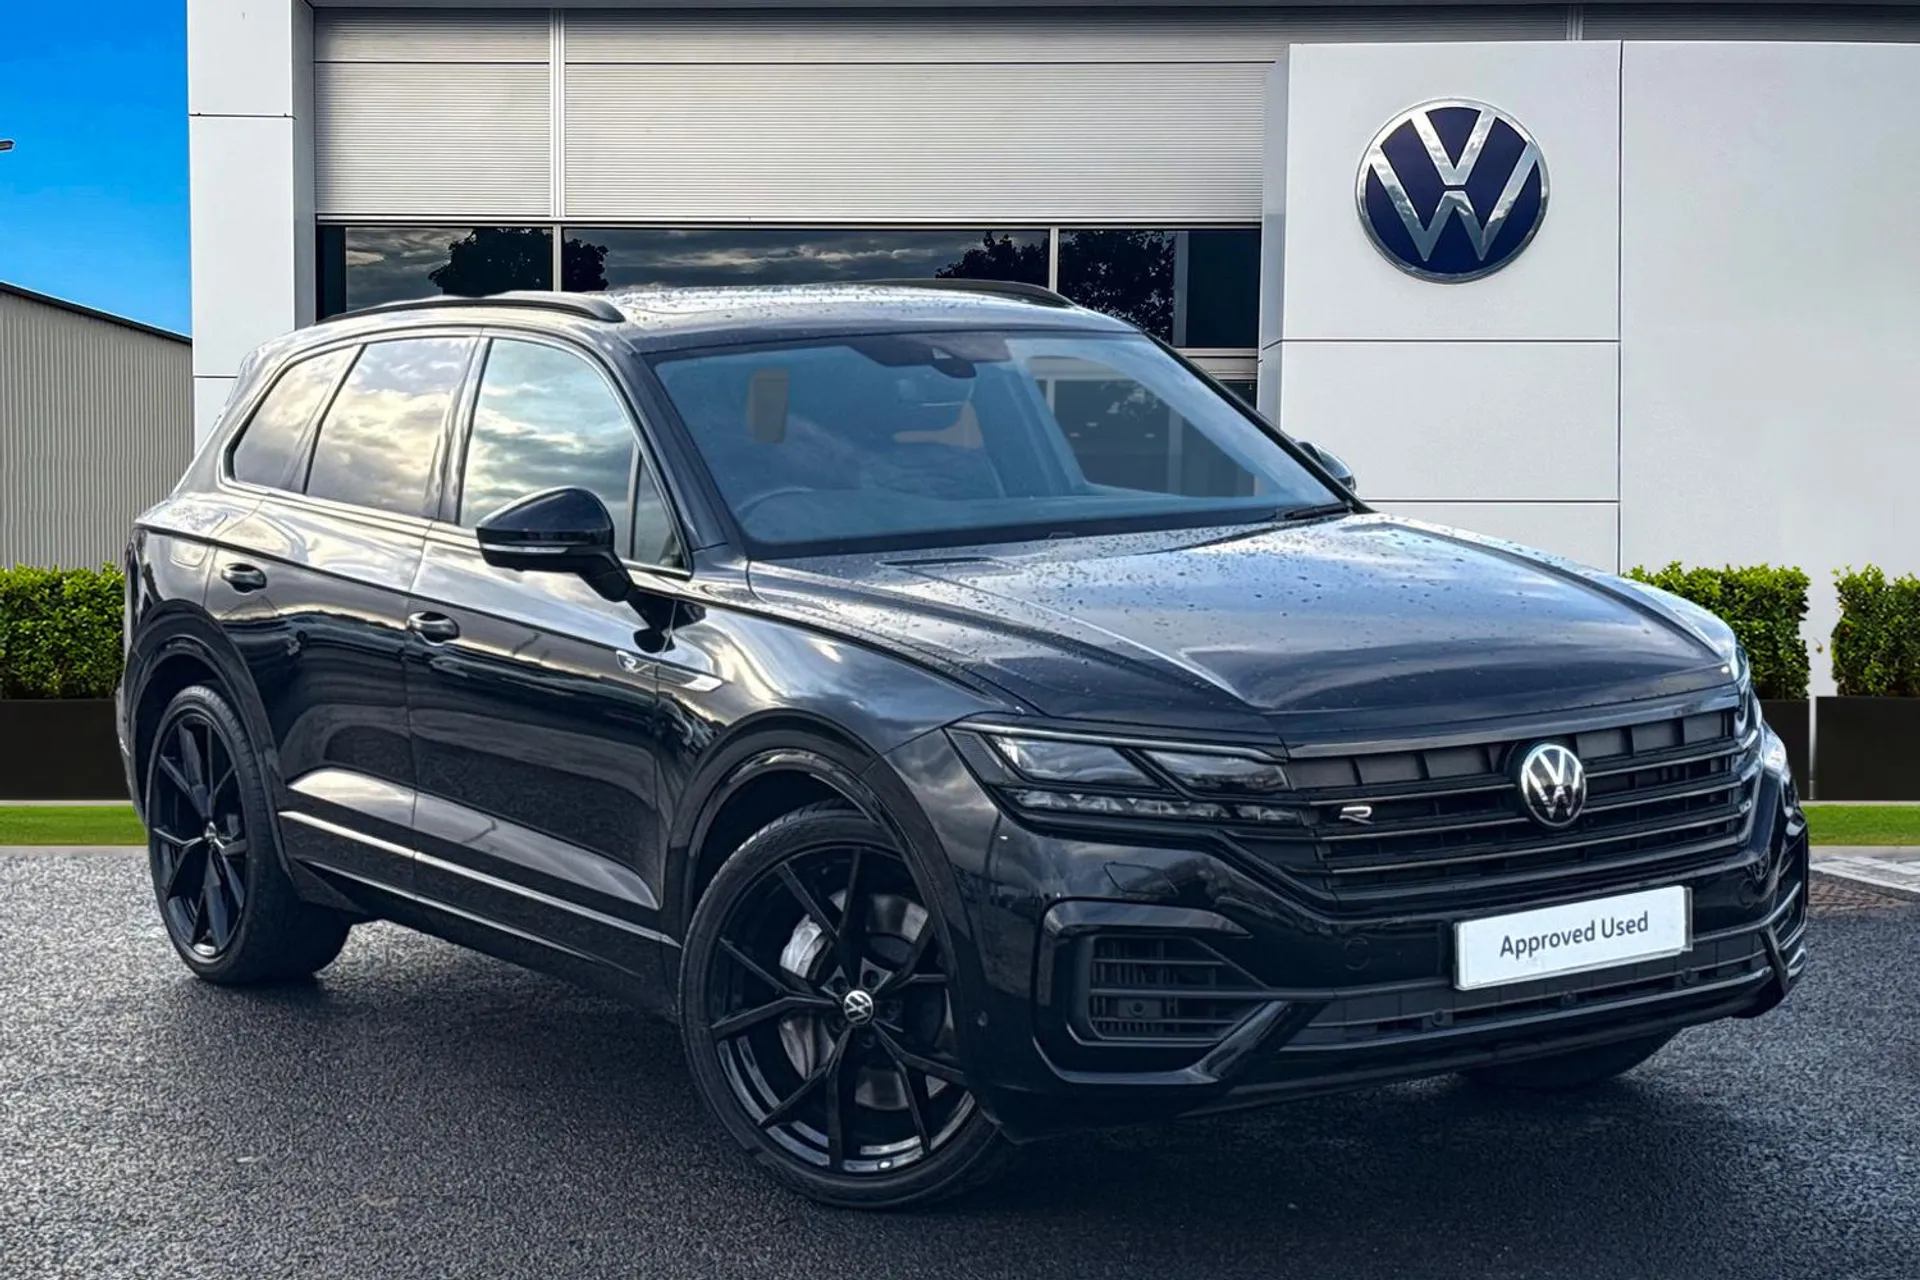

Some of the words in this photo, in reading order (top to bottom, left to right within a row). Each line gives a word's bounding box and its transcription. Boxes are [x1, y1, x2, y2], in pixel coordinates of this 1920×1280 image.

[1363, 102, 1543, 264] VW
[1523, 745, 1584, 822] VW
[1500, 920, 1596, 960] Approved
[1601, 910, 1649, 938] Used
